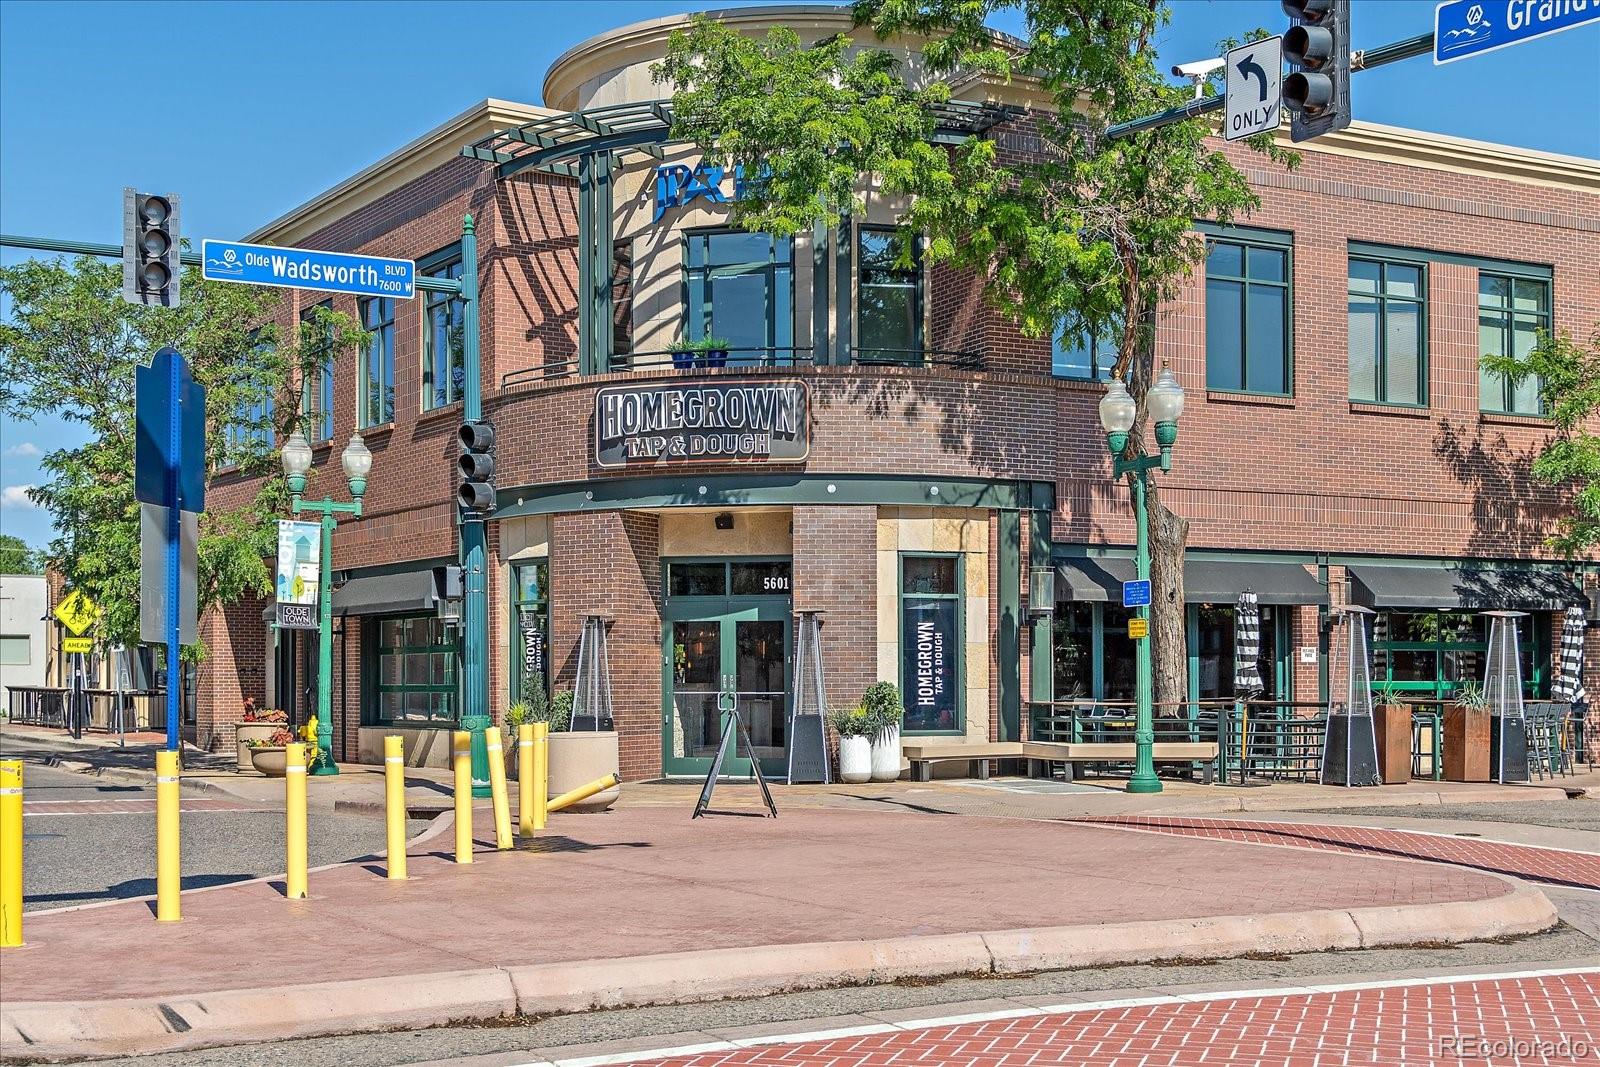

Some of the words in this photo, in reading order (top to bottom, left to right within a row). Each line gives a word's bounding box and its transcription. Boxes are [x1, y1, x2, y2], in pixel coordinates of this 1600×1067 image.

[1507, 0, 1600, 31] Gran
[1233, 105, 1272, 131] ONLY
[245, 253, 270, 268] Olde
[272, 256, 378, 287] Wadsworth
[385, 265, 407, 277] BLVD
[379, 280, 402, 292] 7600
[405, 282, 412, 293] W
[602, 388, 797, 440] HOMEGROWN
[625, 436, 666, 458] TAP
[669, 435, 687, 456] &
[690, 434, 771, 455] DOUGH
[763, 577, 789, 590] 5601
[284, 615, 309, 623] TOWN
[285, 607, 307, 616] OLDE
[526, 627, 537, 677] GROWN
[935, 632, 943, 665] DOUGH
[918, 622, 935, 706] HOMEGROWN
[935, 676, 943, 694] TAP
